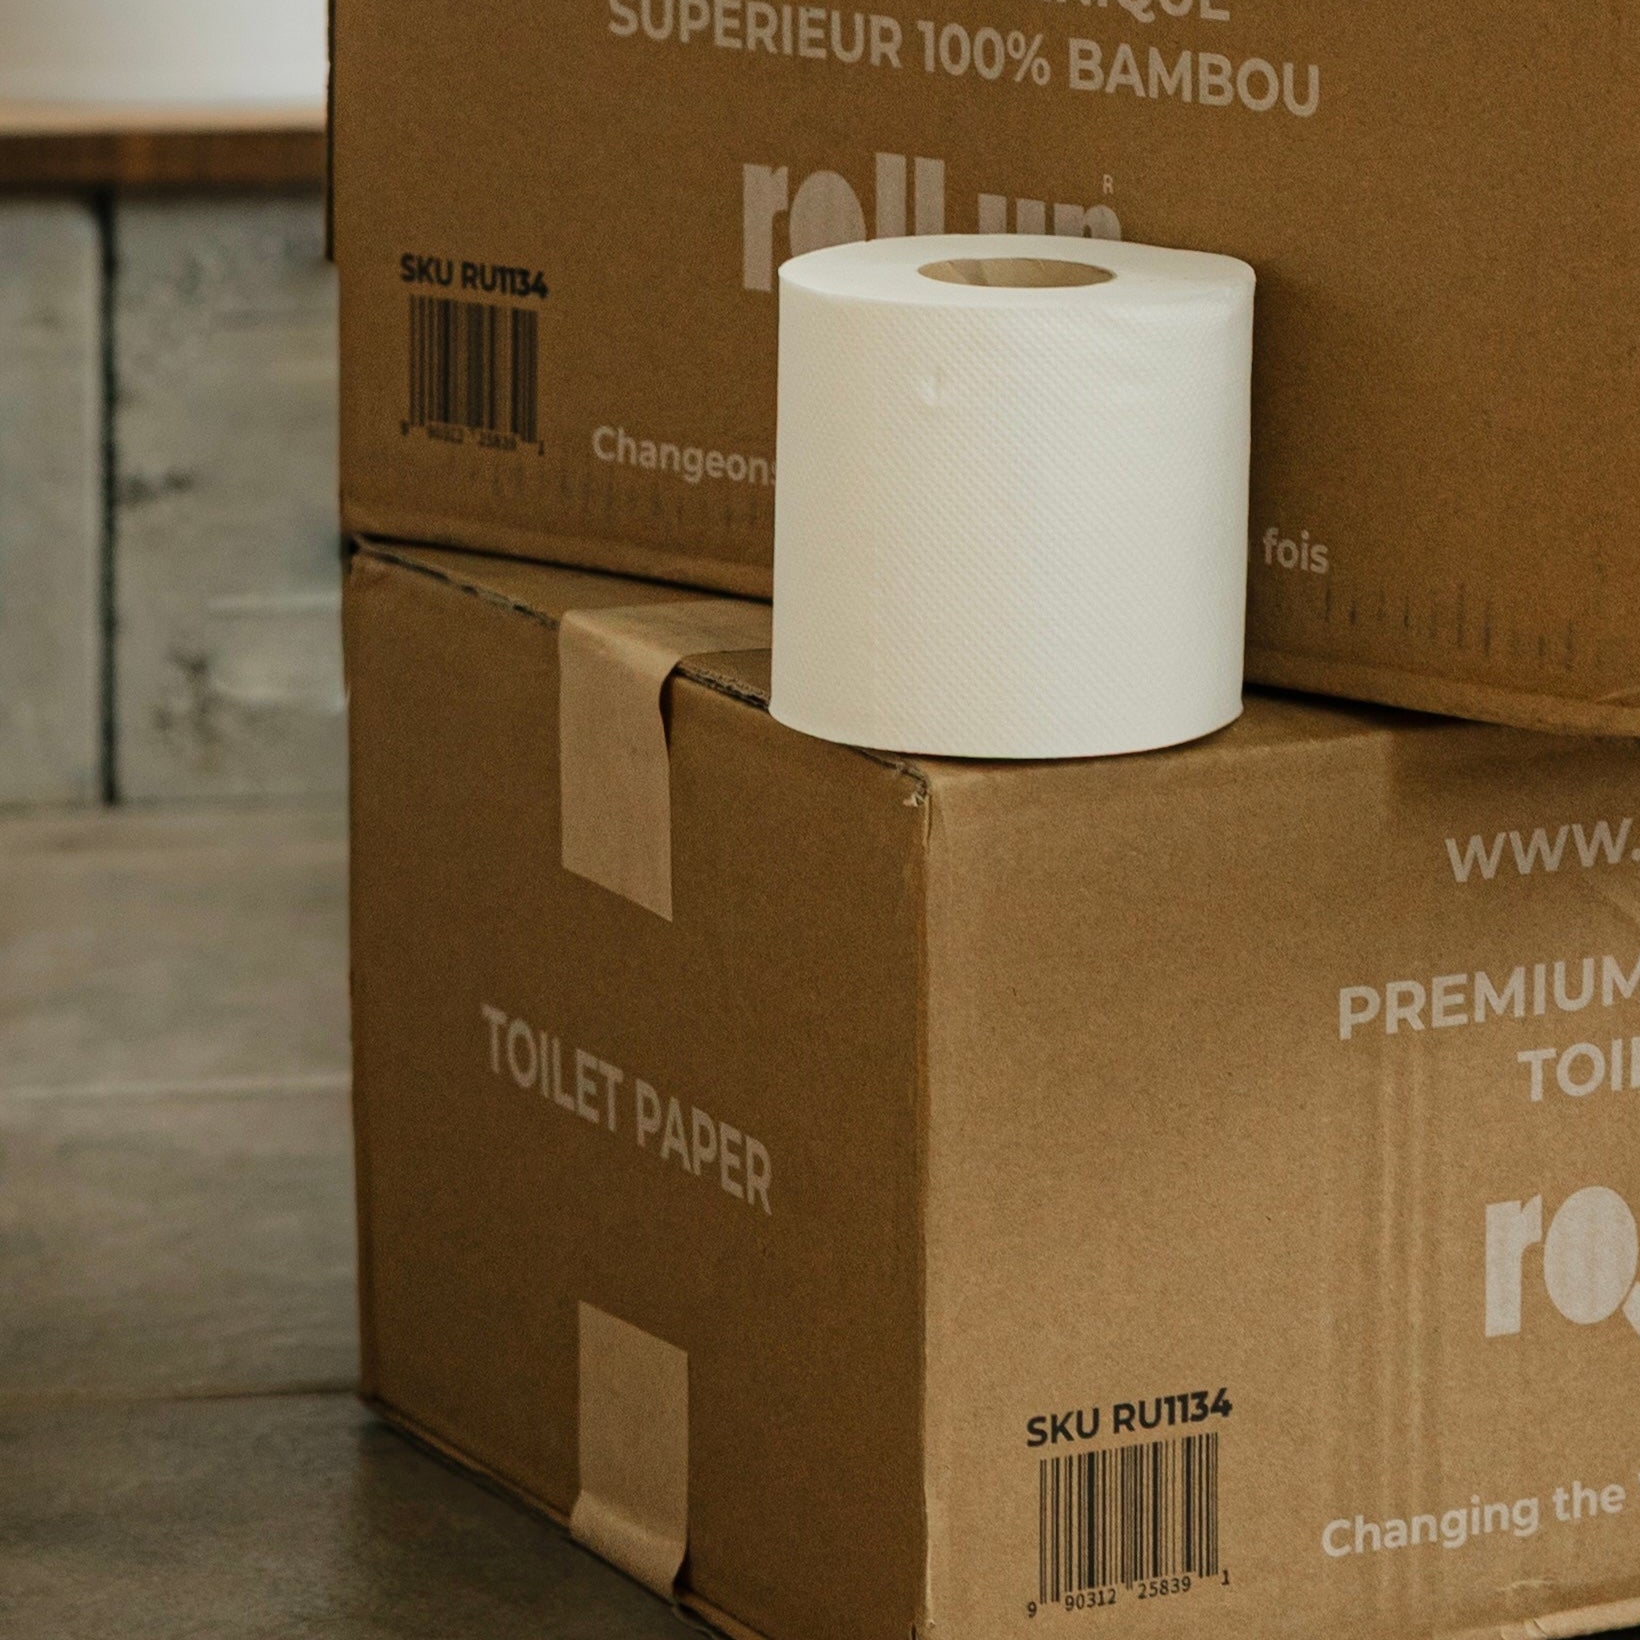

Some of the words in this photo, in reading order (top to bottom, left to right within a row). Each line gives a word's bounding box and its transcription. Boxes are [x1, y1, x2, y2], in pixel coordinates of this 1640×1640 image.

[918, 19, 1052, 87] 100%
[1068, 37, 1322, 119] BAMBOU
[401, 252, 453, 287] SKU
[461, 260, 549, 300] RU1134
[1263, 526, 1330, 574] fois
[481, 1002, 625, 1133] TOILET
[635, 1077, 773, 1217] PAPER
[1026, 1407, 1100, 1447] SKU
[1112, 1387, 1233, 1434] RU1134
[1321, 1494, 1540, 1558] Changing
[1552, 1478, 1627, 1523] the
[1027, 1601, 1037, 1618] 9
[1065, 1588, 1117, 1611] 90312
[1137, 1575, 1192, 1599] 25839
[1221, 1570, 1230, 1586] 1
